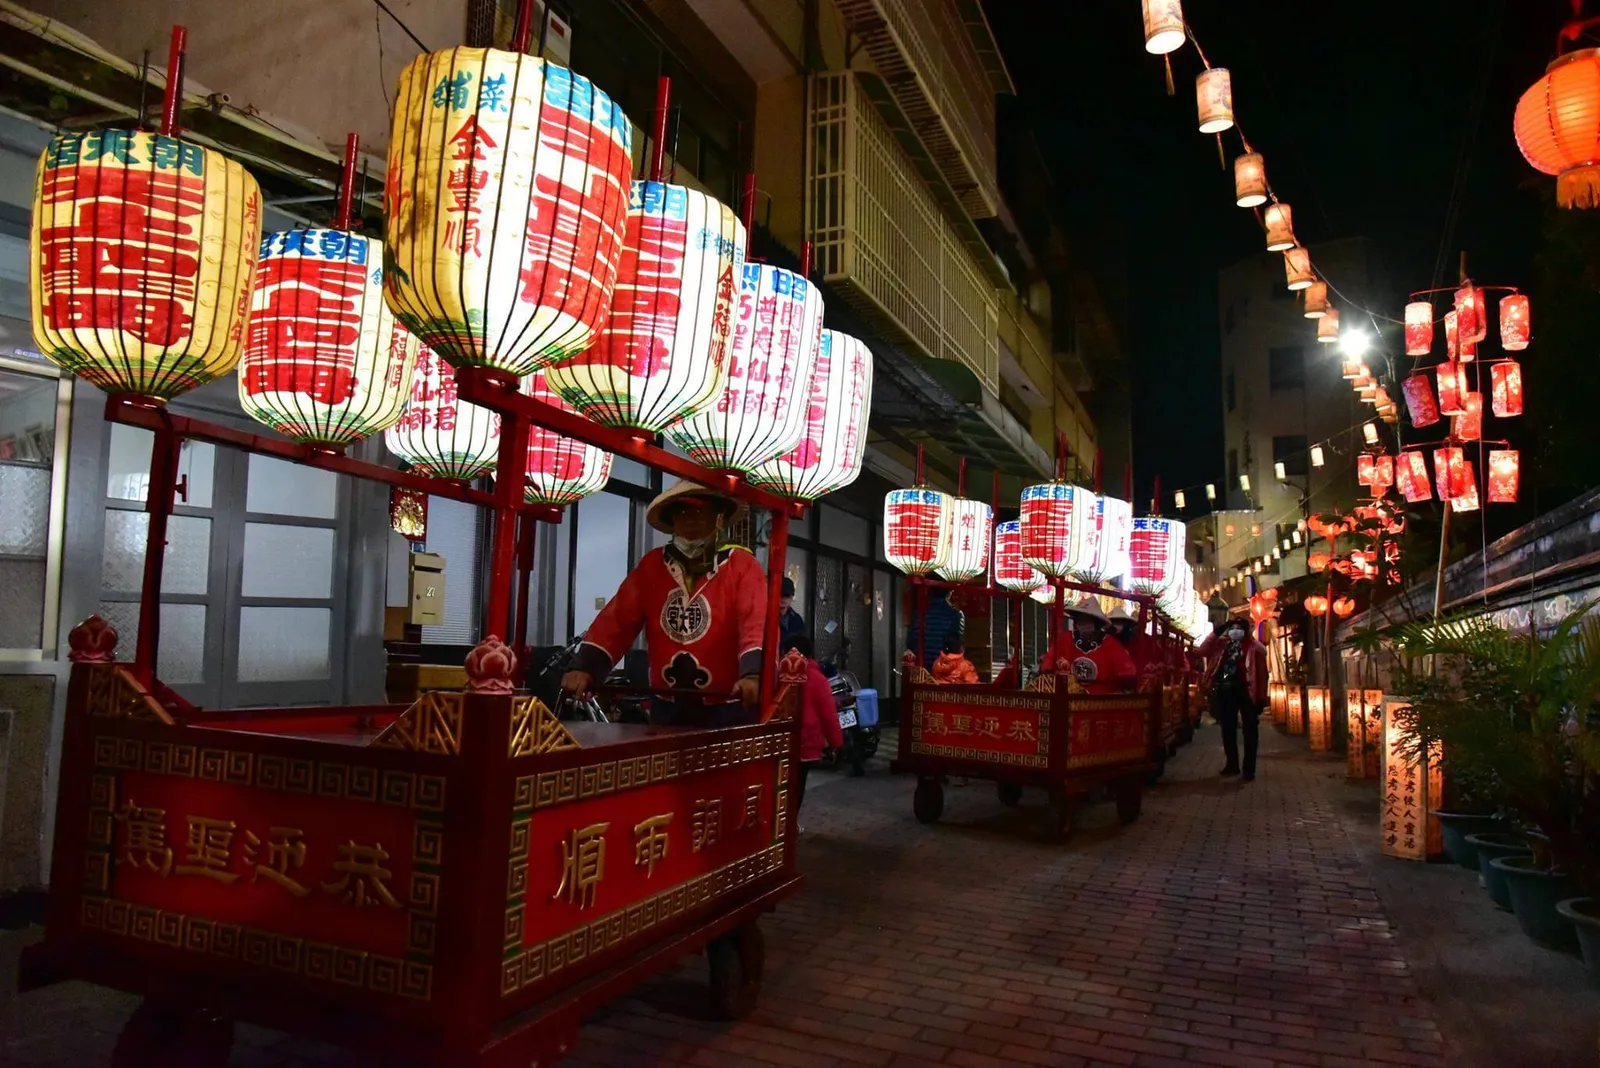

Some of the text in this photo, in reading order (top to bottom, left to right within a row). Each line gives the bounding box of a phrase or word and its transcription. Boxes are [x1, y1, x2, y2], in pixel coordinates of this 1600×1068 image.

[47, 129, 204, 175] 朝天宮
[440, 114, 499, 259] 金豐順
[385, 319, 410, 393] 福順
[708, 265, 737, 373] 金福順
[411, 342, 432, 438] 庵仙師
[115, 799, 404, 909] 恭迎聖駕
[552, 783, 767, 911] 風調雨順
